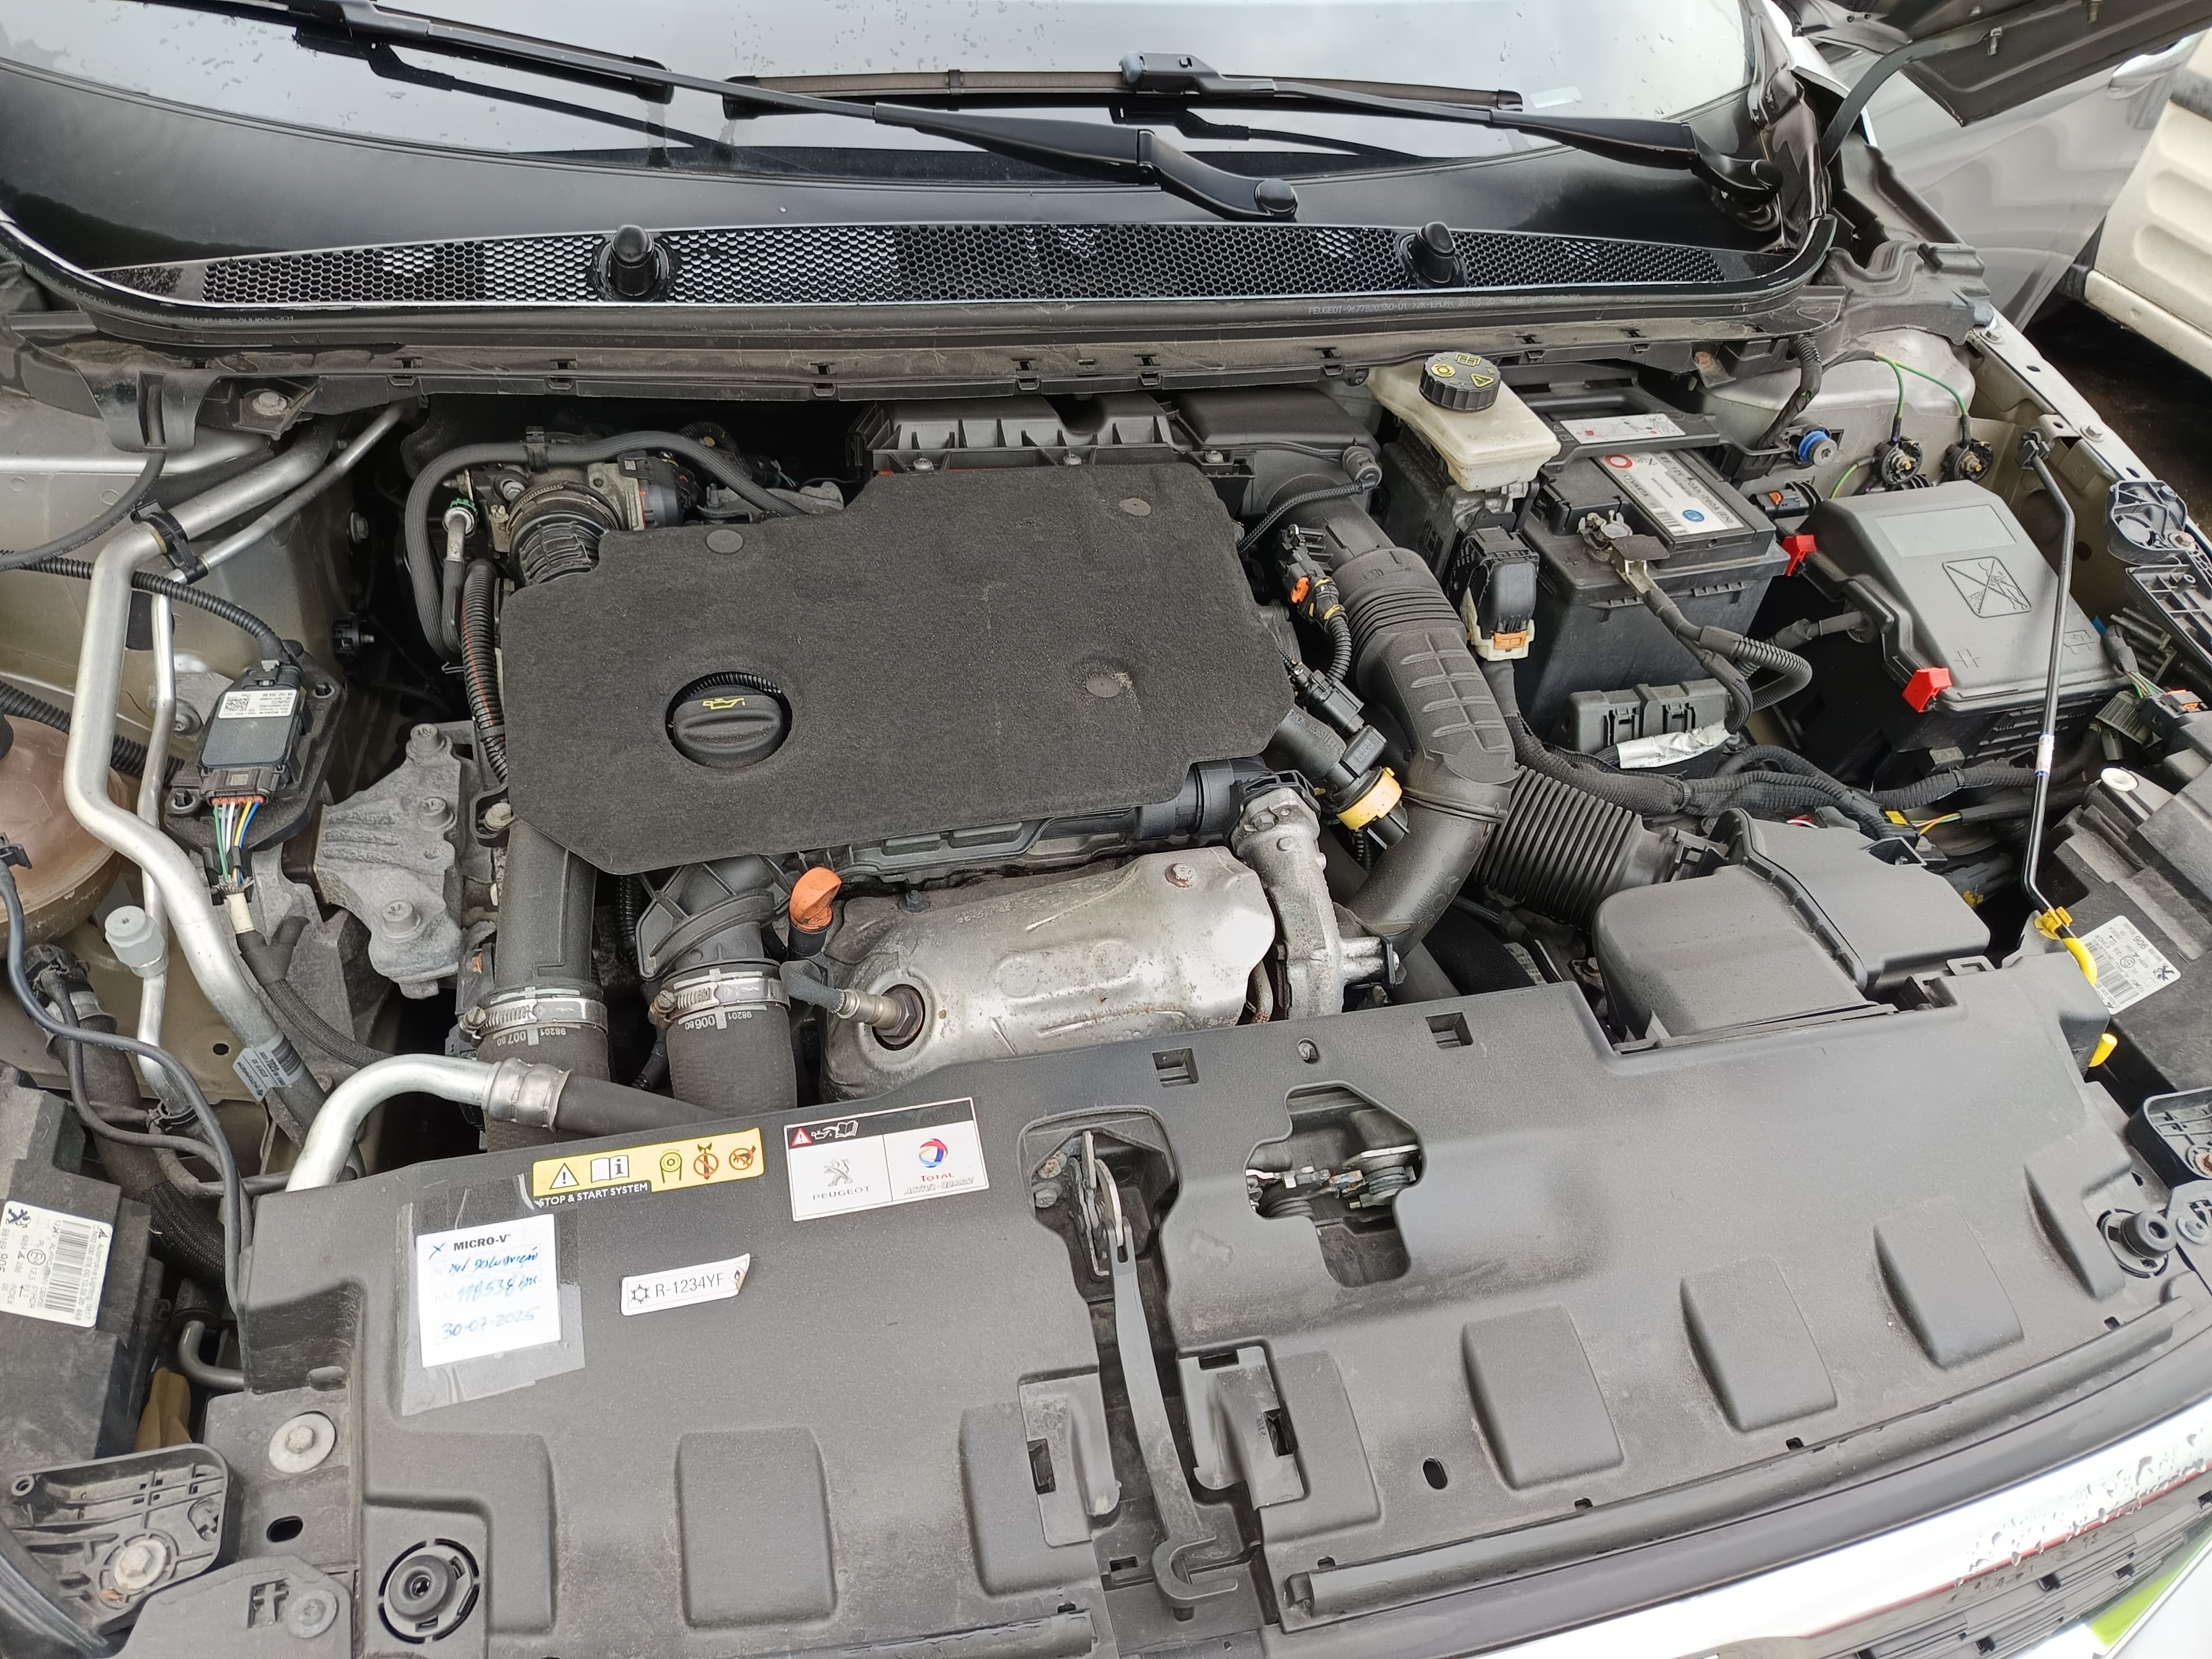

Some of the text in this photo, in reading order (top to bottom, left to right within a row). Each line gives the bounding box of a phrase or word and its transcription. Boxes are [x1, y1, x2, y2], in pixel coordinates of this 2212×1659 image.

[2131, 935, 2149, 950] 906
[728, 1011, 752, 1020] 98201
[539, 1027, 567, 1037] 98201
[919, 1173, 955, 1182] TOTAL
[539, 1183, 648, 1206] STOP & START SYSTEM
[812, 1185, 870, 1200] PEUGEOT
[453, 1234, 507, 1251] MICRO-V
[656, 1272, 724, 1297] R-1234YF
